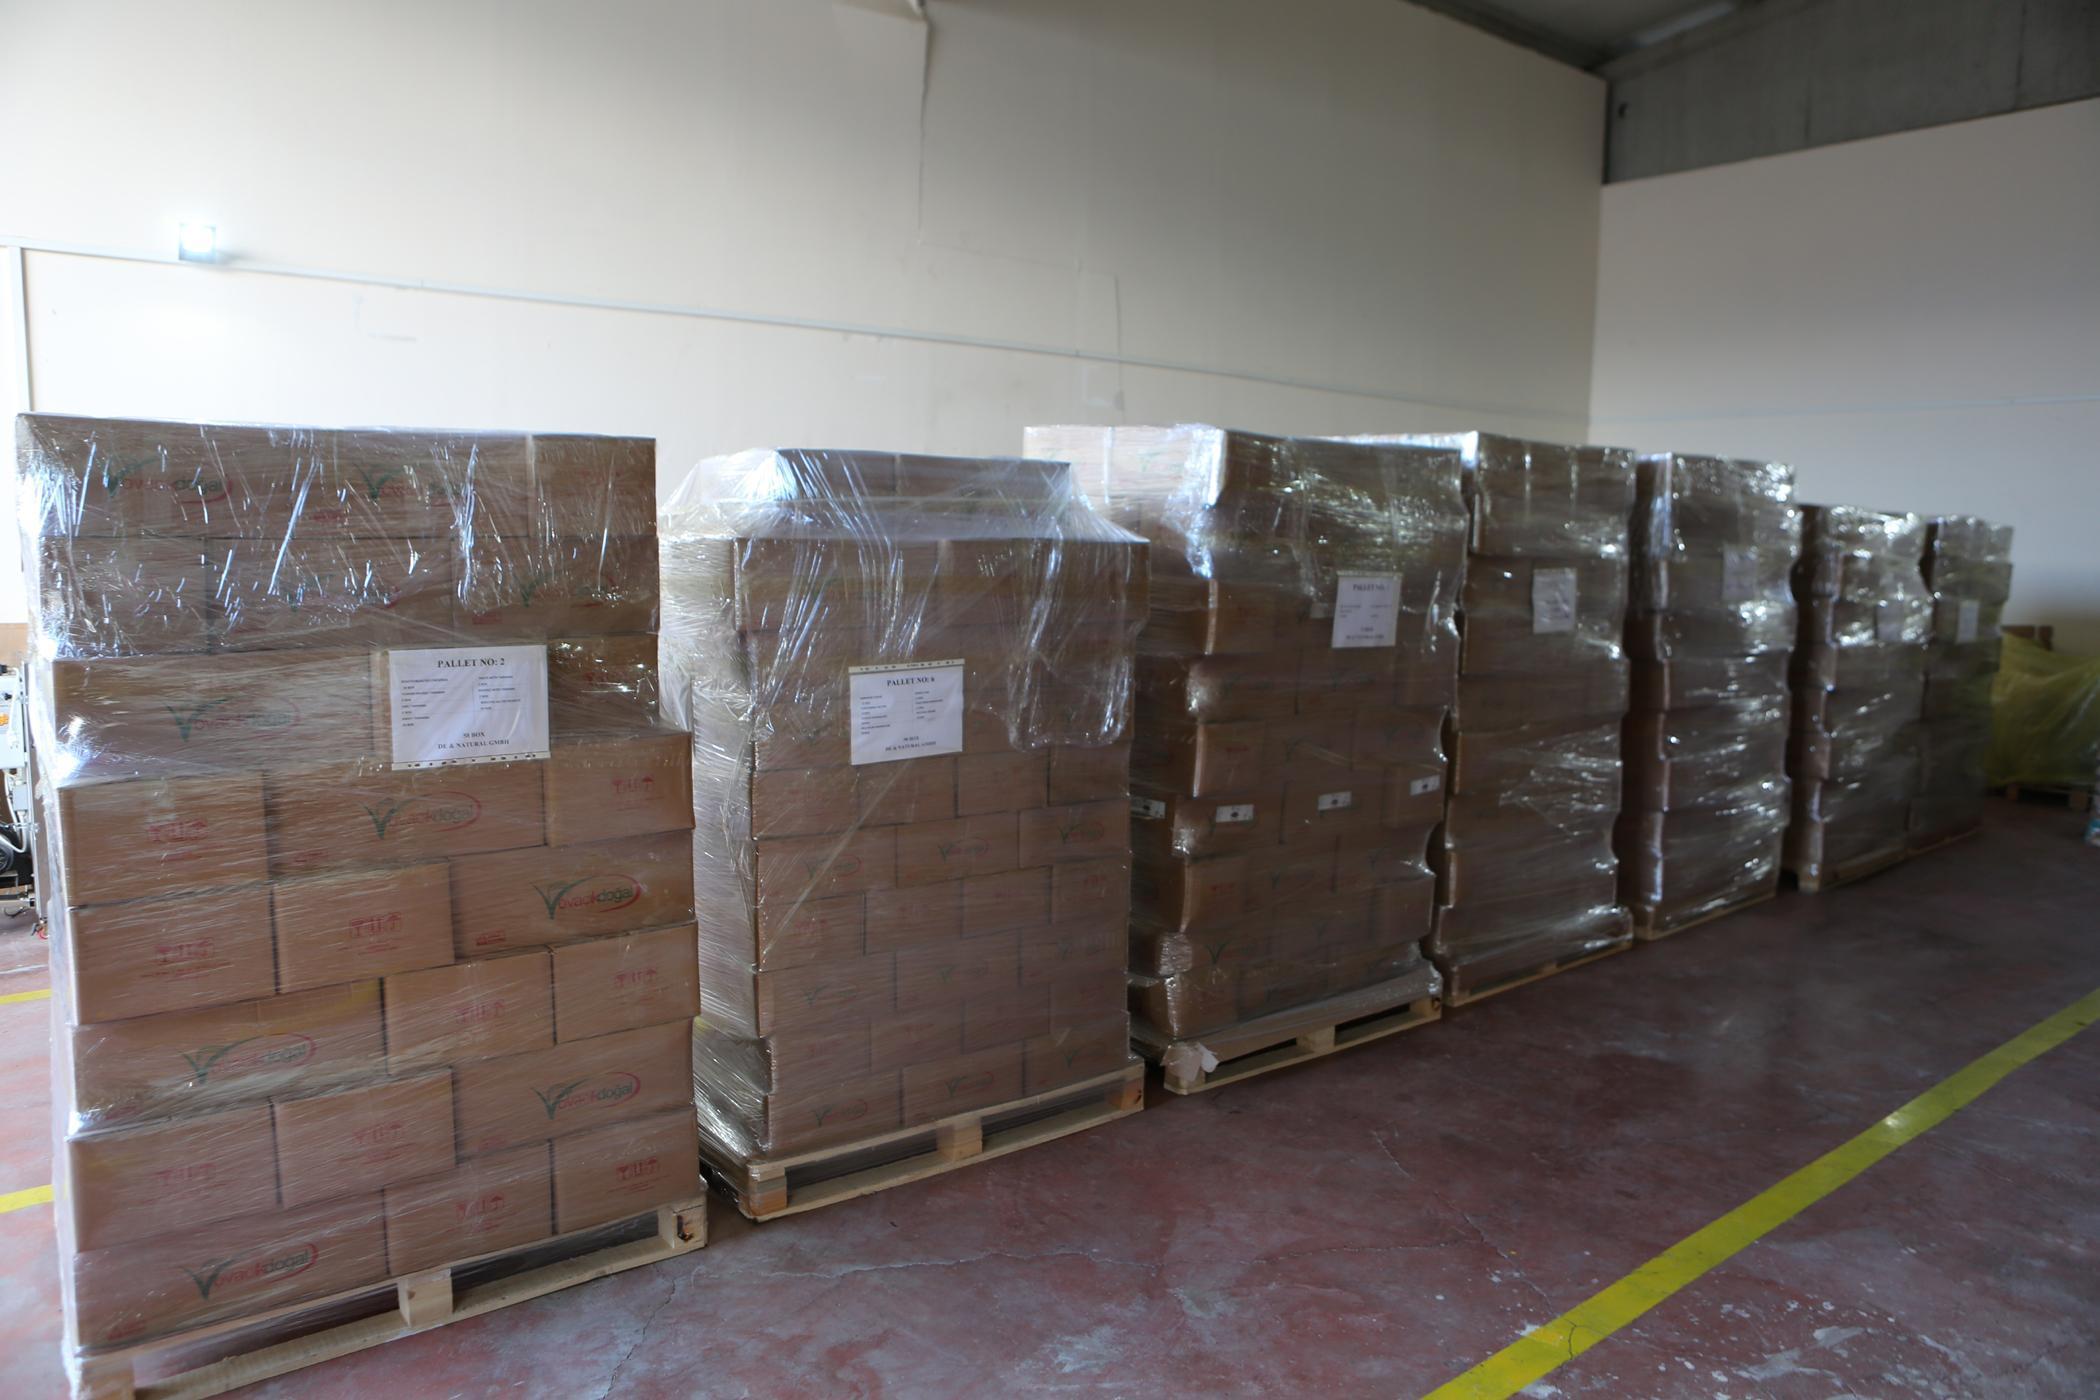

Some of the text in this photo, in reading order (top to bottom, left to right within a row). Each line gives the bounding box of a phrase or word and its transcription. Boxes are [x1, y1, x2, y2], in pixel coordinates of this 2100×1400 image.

[437, 657, 505, 668] PALLET NO: 2
[887, 678, 914, 687] PALLET
[456, 740, 487, 749] NATURAL
